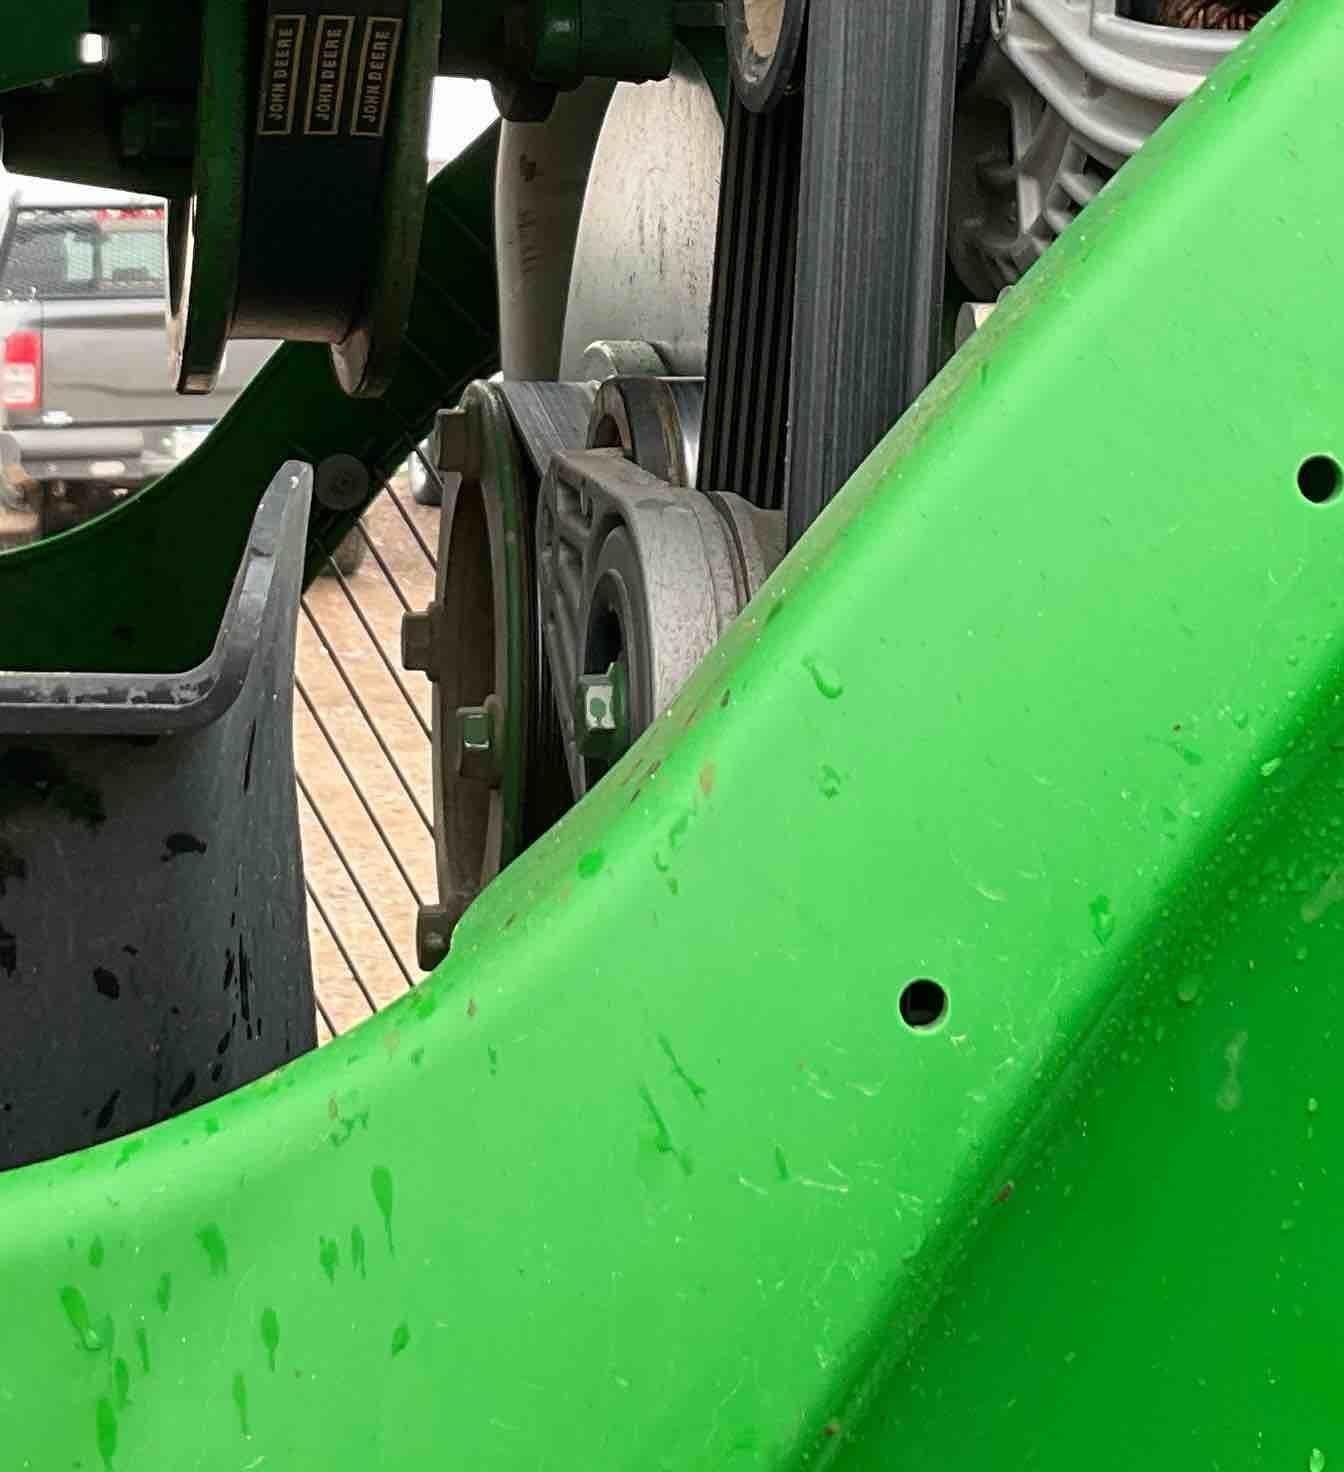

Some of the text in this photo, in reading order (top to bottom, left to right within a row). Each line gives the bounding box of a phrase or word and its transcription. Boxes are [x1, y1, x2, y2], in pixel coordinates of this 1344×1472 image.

[268, 27, 293, 121] JOHN DEERE
[315, 29, 341, 121] JOHN DEERE
[361, 30, 390, 122] JOHN DEERE
